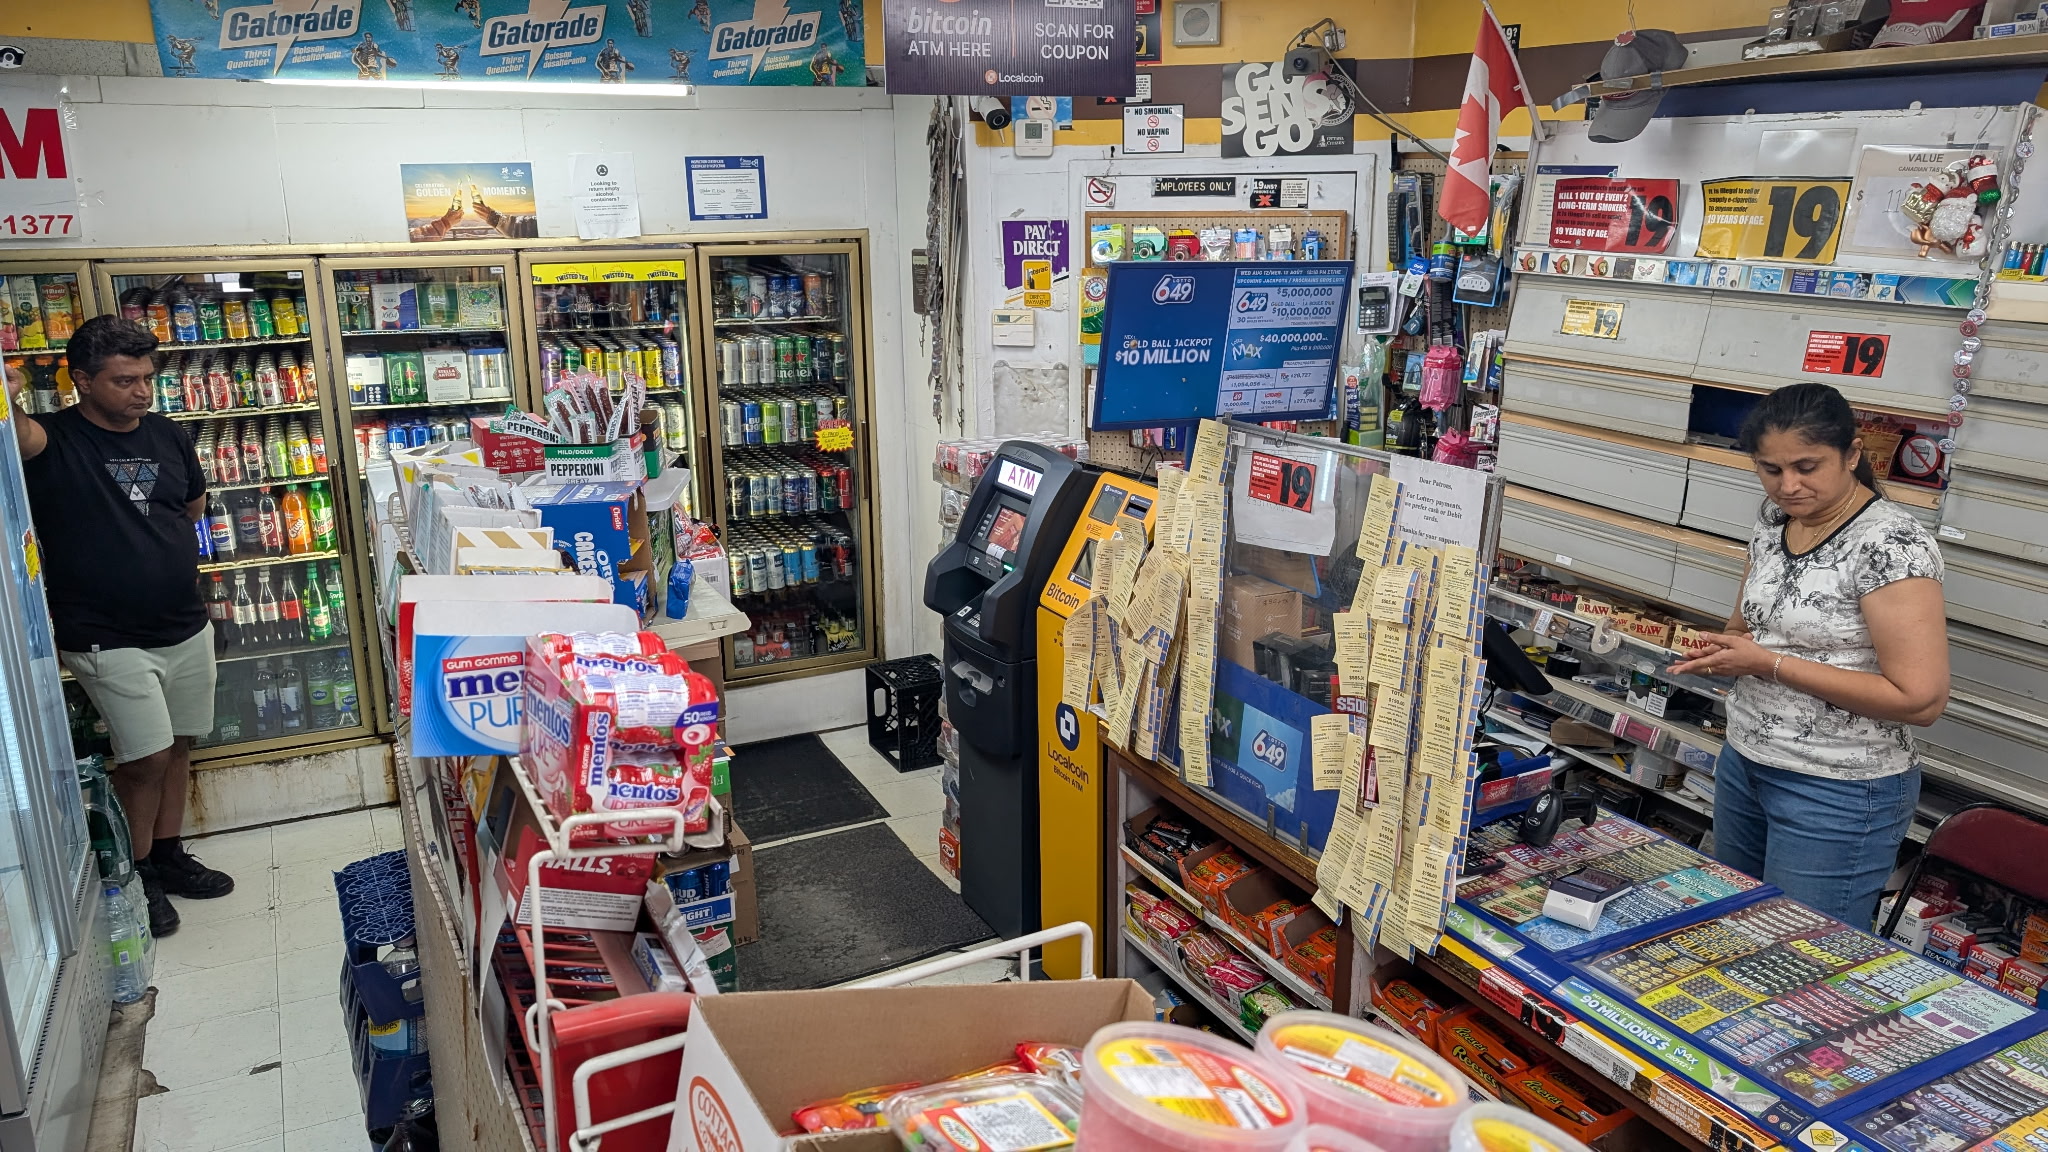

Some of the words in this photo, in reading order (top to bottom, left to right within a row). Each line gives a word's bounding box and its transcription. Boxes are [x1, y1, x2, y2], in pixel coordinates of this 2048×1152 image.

[228, 6, 352, 41] Gatorade
[908, 7, 991, 35] bitcoin
[488, 16, 597, 49] Gatorade
[716, 21, 813, 52] Gatorade
[1036, 23, 1079, 38] SCAN
[1084, 24, 1114, 39] FOR
[244, 50, 271, 59] Thirst
[294, 44, 325, 55] Boisson
[545, 50, 572, 61] Boisson
[908, 40, 943, 56] ATM
[950, 42, 991, 57] HERE
[1041, 45, 1109, 60] COUPON
[227, 57, 270, 70] Quencher
[502, 55, 525, 65] Thirst
[727, 59, 748, 68] Thirst
[486, 63, 523, 75] Quencher
[713, 67, 746, 78] Quencher
[999, 72, 1043, 83] Localcoin
[1144, 107, 1173, 115] SMOKING
[1149, 128, 1170, 136] VAPING
[1243, 120, 1314, 157] GO
[1908, 154, 1944, 162] VALUE
[416, 188, 451, 197] GOLDEN
[483, 186, 526, 196] MOMENTS
[1156, 182, 1205, 191] EMPLOYEES
[1210, 182, 1232, 191] ONLY
[1857, 190, 1864, 201] $
[1558, 202, 1597, 210] LONG-TERM
[1625, 195, 1673, 247] 19
[1708, 215, 1716, 224] 19
[1717, 215, 1737, 224] YEARS
[1739, 216, 1748, 224] OF
[1749, 216, 1764, 224] AGE.
[1764, 185, 1840, 259] 19
[1024, 225, 1047, 239] PAY
[1565, 227, 1585, 236] YEARS
[1596, 229, 1609, 238] AGE.
[1013, 241, 1060, 256] DIRECT
[555, 273, 578, 282] TWISTED
[1277, 288, 1332, 298] $5,000,000
[1272, 307, 1331, 317] $10,000,000
[1594, 309, 1618, 336] 19
[1151, 339, 1171, 348] BALL
[1175, 338, 1212, 347] JACKPOT
[1260, 332, 1322, 343] $40,000,000
[1115, 350, 1139, 365] $10
[1143, 349, 1210, 365] MILLION
[1232, 344, 1263, 360] MAX
[1842, 336, 1884, 375] 19
[1473, 407, 1497, 418] Energizer
[507, 421, 559, 443] PEPPERONI
[551, 463, 604, 477] PEPPERONI
[1008, 466, 1036, 490] ATM
[1280, 461, 1312, 508] 19
[1419, 476, 1431, 485] Dear
[1432, 480, 1453, 491] Patrons,
[1406, 492, 1416, 500] For
[1416, 494, 1435, 505] Lottery
[1436, 498, 1462, 511] payments,
[1412, 502, 1430, 512] prefer
[1447, 508, 1462, 520] Debit
[1424, 514, 1438, 523] cards.
[1399, 525, 1417, 536] Thanks
[1424, 533, 1437, 542] your
[1437, 535, 1461, 546] support.
[574, 532, 598, 576] CAKES
[1046, 583, 1080, 610] Bitcoin
[1551, 592, 1576, 603] RAW
[1583, 604, 1610, 616] RAW
[1636, 623, 1662, 635] RAW
[576, 656, 658, 674] mentos
[1391, 690, 1405, 698] TOTAL
[526, 686, 571, 745] mentos
[683, 711, 700, 723] 50
[1436, 715, 1451, 724] TOTAL
[590, 712, 609, 786] mentos
[1047, 741, 1089, 785] Localcoin
[1053, 765, 1071, 785] Bitcoin
[1072, 779, 1083, 792] ATM
[1437, 807, 1450, 816] TOTAL
[1618, 831, 1651, 846] 30
[1424, 862, 1437, 871] TOTAL
[1528, 859, 1560, 870] 30
[1932, 928, 1961, 946] TYLENOL
[1671, 934, 1722, 961] GOLDEN
[1790, 940, 1853, 967] BOOST
[1924, 949, 1959, 969] REACTINE
[1971, 950, 2000, 970] TYLENOL
[1726, 969, 1768, 993] SUPER
[2009, 967, 2039, 987] TYLENOL
[1581, 995, 1599, 1008] 90
[1597, 1005, 1658, 1045] MILLIONS
[1657, 1041, 1670, 1051] $
[1452, 1026, 1489, 1052] Reese's
[1674, 1047, 1698, 1064] MAX
[1452, 1046, 1498, 1089] Reese's
[1521, 1079, 1564, 1106] Reese's
